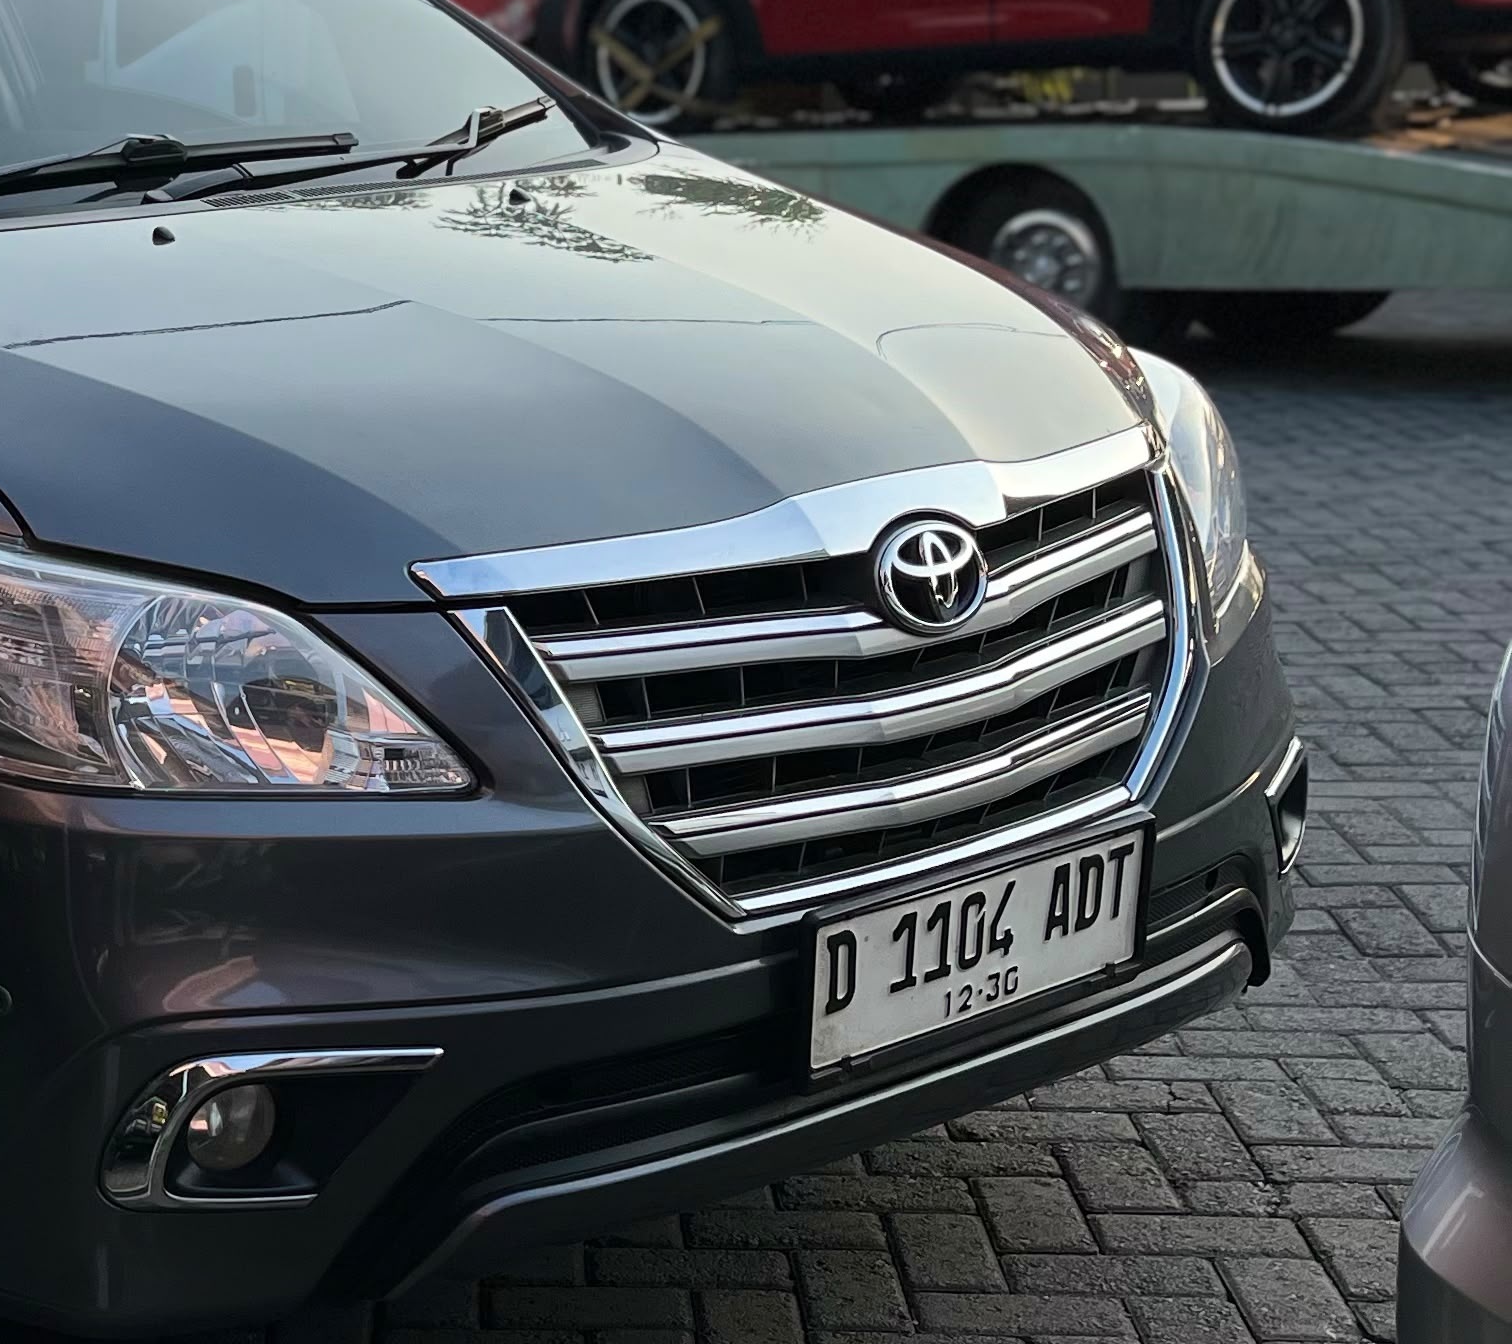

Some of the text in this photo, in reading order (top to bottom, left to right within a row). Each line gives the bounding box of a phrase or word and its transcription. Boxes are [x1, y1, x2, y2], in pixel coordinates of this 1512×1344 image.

[825, 843, 1135, 1015] D 1104 ADT
